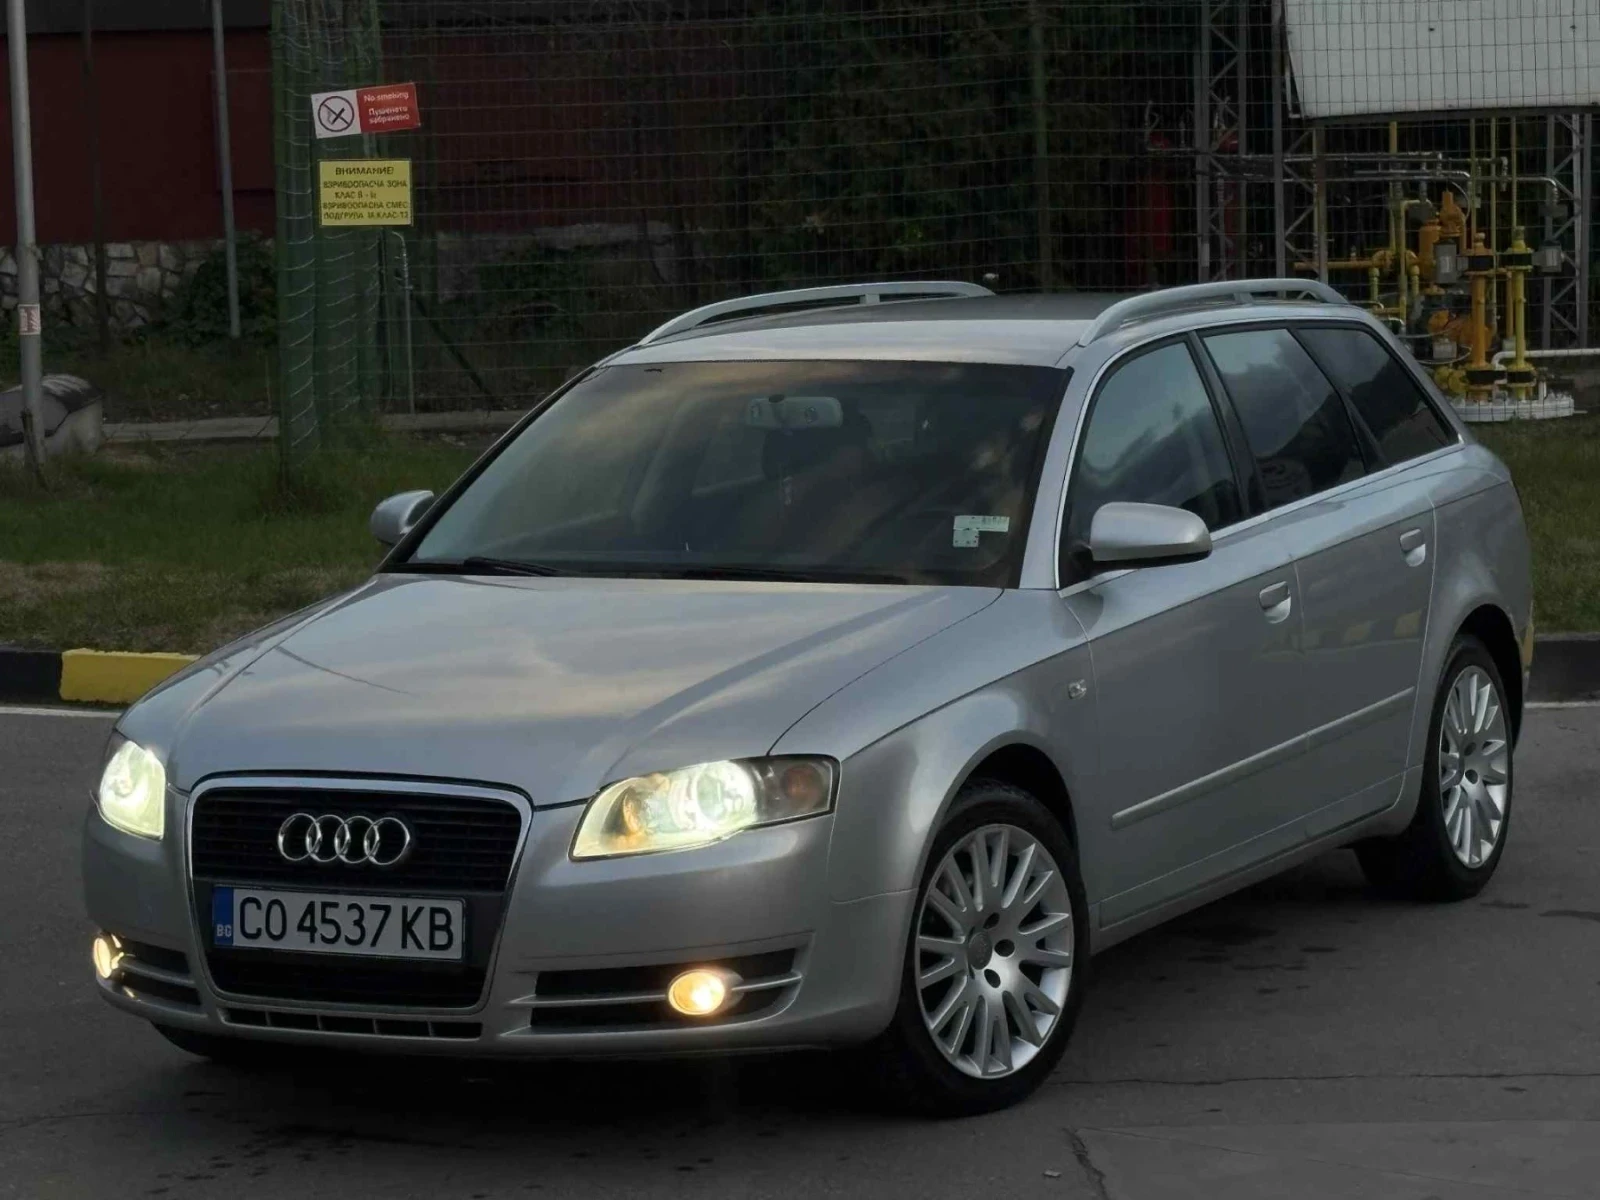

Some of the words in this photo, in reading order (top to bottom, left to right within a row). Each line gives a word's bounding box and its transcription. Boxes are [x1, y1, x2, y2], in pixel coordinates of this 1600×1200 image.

[363, 94, 376, 102] No
[377, 92, 409, 100] smoking
[386, 180, 408, 188] ЗОНА
[216, 924, 232, 937] BG
[296, 900, 392, 948] 4537
[400, 905, 454, 951] KB
